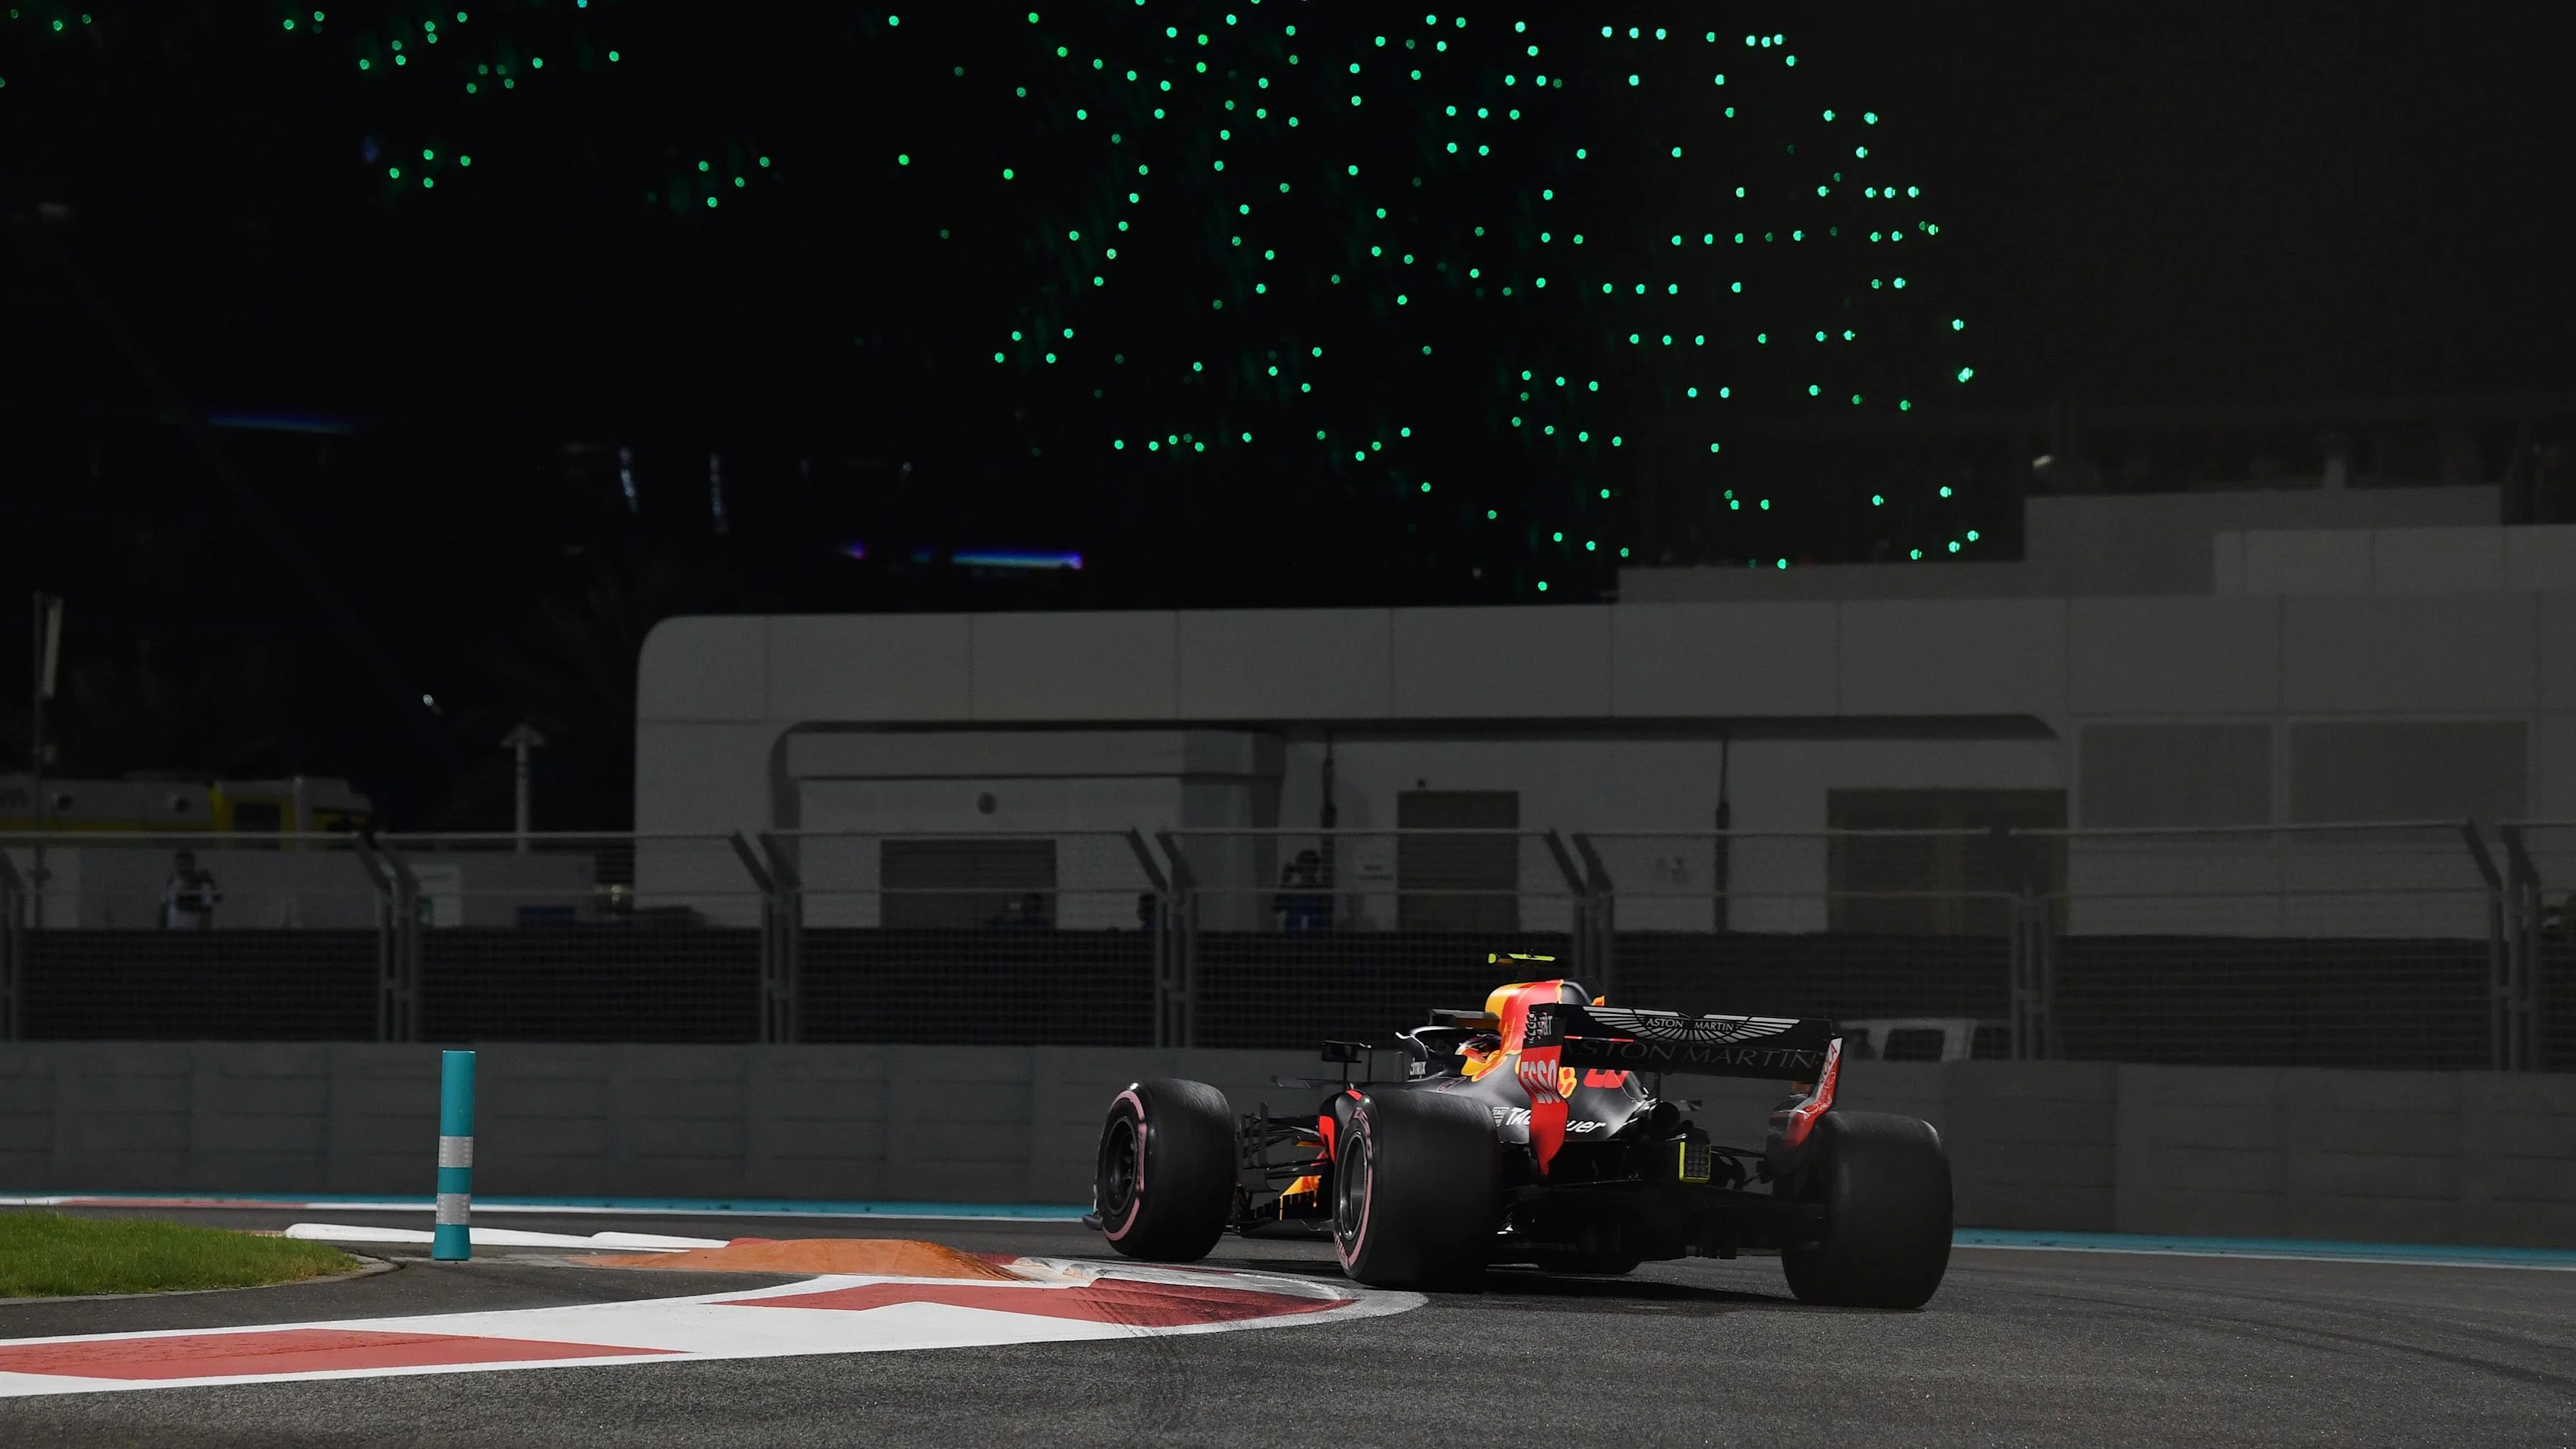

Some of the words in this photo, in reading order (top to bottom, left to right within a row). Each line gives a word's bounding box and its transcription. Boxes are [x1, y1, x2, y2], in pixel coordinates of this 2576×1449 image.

[1646, 1018, 1684, 1028] ASTON
[1694, 1021, 1735, 1031] MARTIN
[1680, 1045, 1817, 1069] MARTIN
[1564, 1119, 1607, 1133] uer
